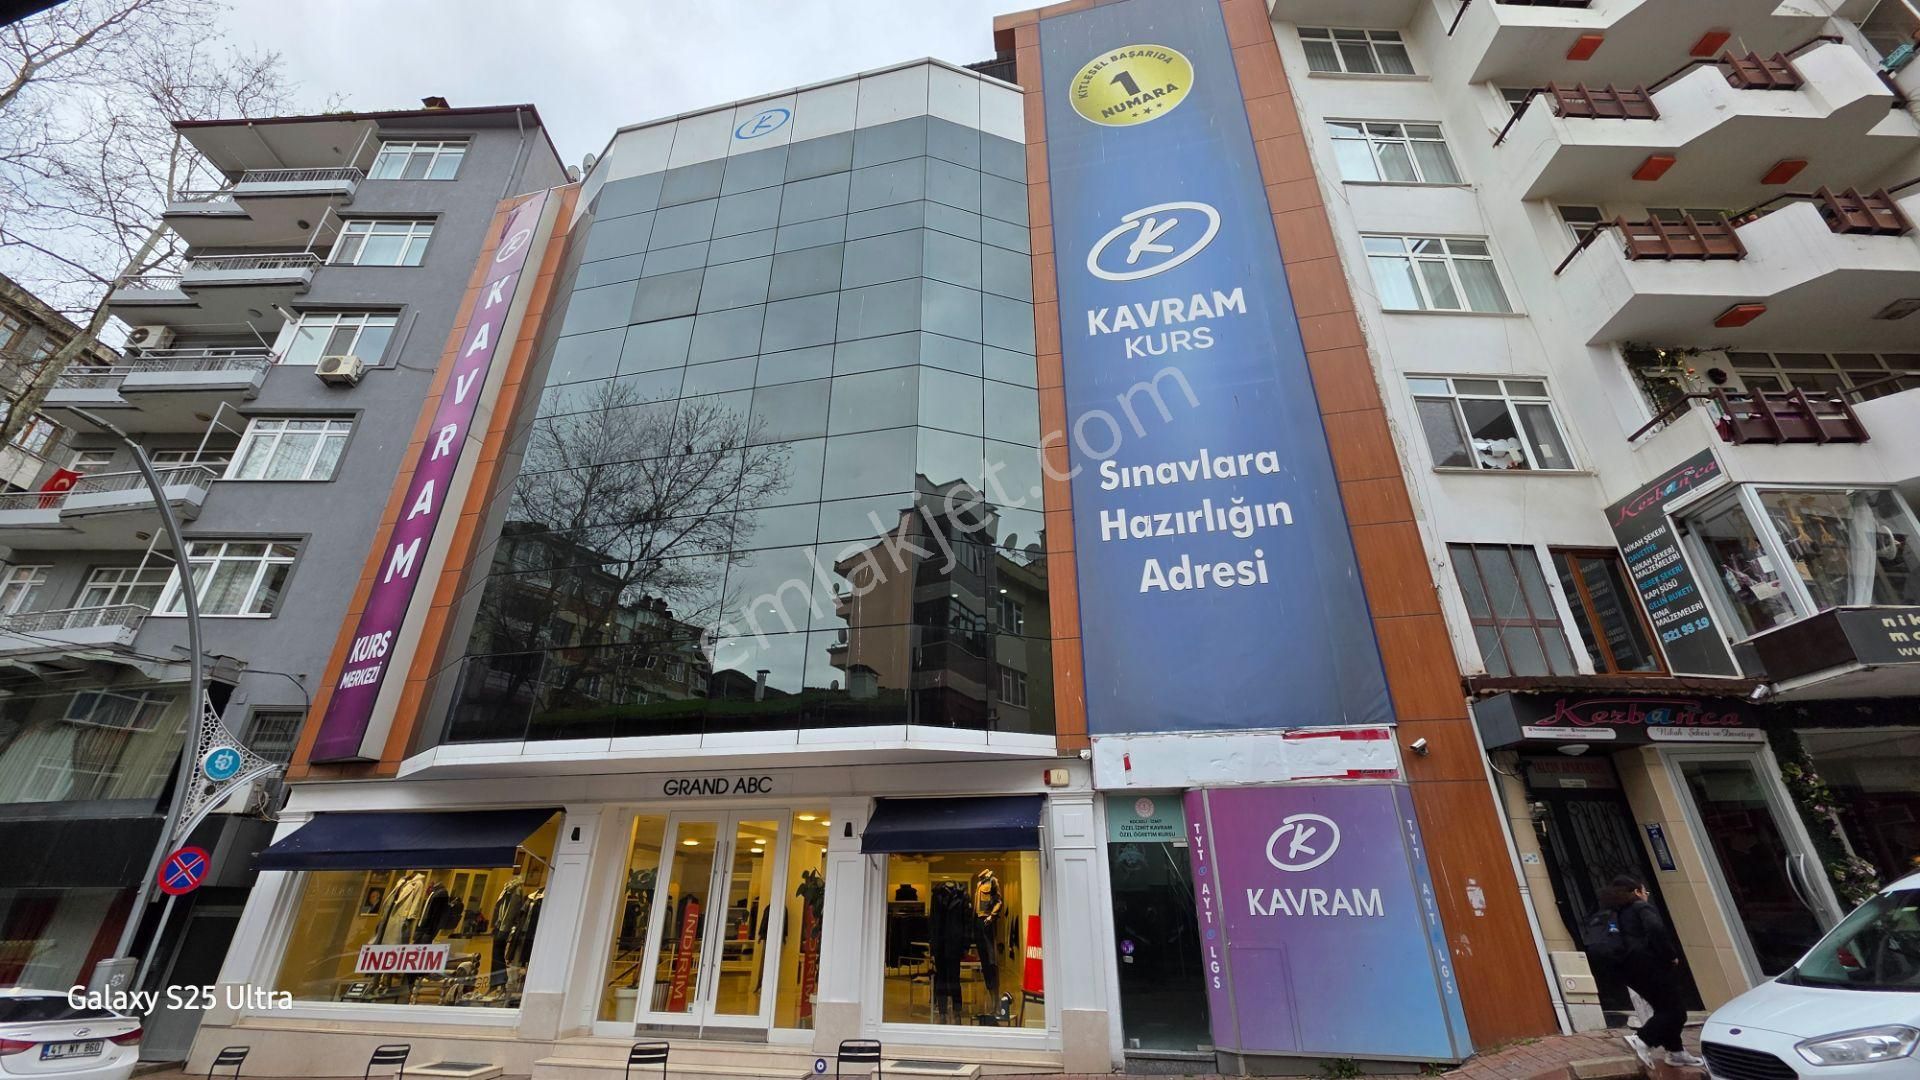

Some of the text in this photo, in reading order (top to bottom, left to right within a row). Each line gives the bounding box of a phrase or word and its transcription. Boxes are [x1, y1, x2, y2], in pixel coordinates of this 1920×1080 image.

[1077, 50, 1174, 100] KİTLESEL BAŞARIDA
[1110, 70, 1141, 96] 1
[1101, 83, 1179, 118] NUMARA
[1087, 287, 1247, 336] KAVRAM
[1124, 326, 1215, 359] KURS
[384, 275, 511, 584] KAVRAM
[1100, 448, 1281, 491] Sınavlara
[1100, 496, 1294, 541] Hazırlığın
[1624, 524, 1666, 553] NİKAH ŞEKERİ
[1139, 548, 1269, 593] Adresi
[1632, 545, 1676, 573] NİKAH ŞEKERİ
[1635, 551, 1681, 579] MALZEMELERİ
[1644, 588, 1660, 600] KAPI
[1652, 607, 1670, 620] KINA
[1655, 600, 1704, 628] MALZEMELERİ
[348, 630, 392, 663] KURS
[339, 661, 383, 689] MERKEZİ
[663, 776, 773, 796] GRAND ABC
[1193, 823, 1204, 861] TYT
[1406, 819, 1421, 859] TYT
[1202, 883, 1212, 923] AYT
[1247, 888, 1385, 917] KAVRAM
[1422, 883, 1436, 925] AYT
[360, 946, 444, 972] İNDİRİM
[1210, 947, 1221, 989] LGS
[1437, 949, 1454, 994] LGS
